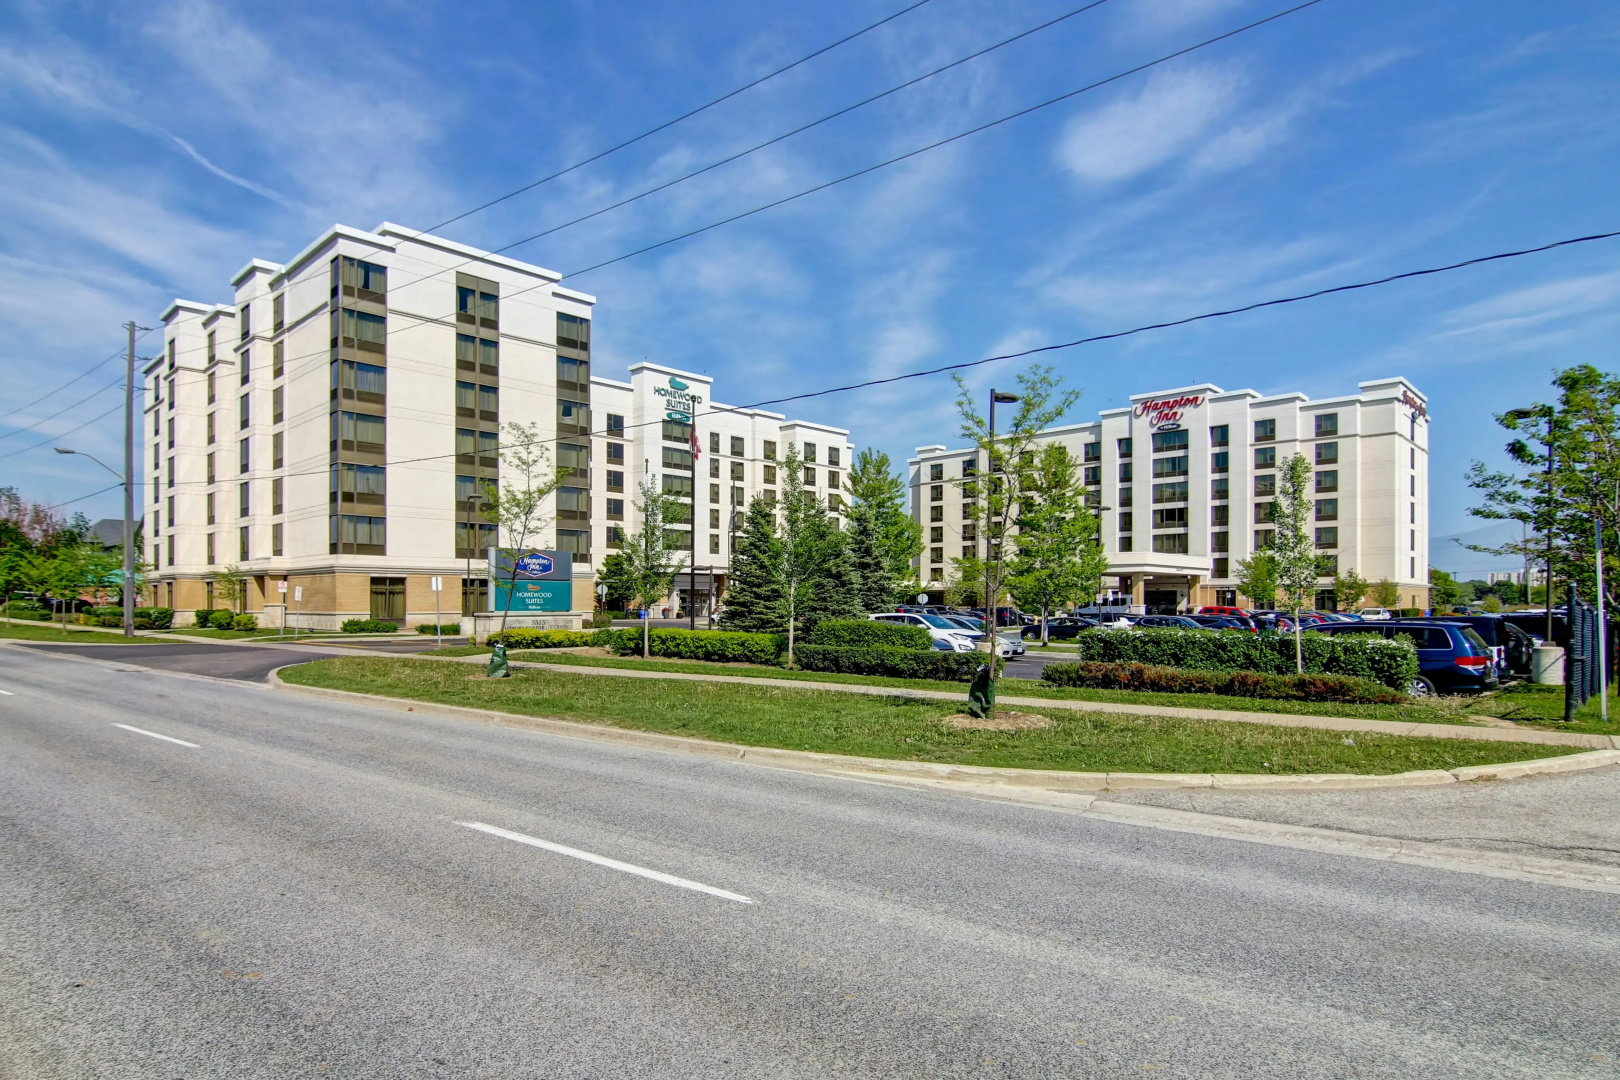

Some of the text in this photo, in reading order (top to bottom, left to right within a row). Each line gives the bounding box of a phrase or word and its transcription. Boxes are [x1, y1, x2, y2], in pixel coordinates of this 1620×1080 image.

[653, 386, 702, 404] HOMEWOD
[666, 399, 691, 411] SUITES
[1134, 396, 1205, 417] Hampton
[1151, 410, 1184, 426] Inn
[519, 557, 550, 565] Hampton
